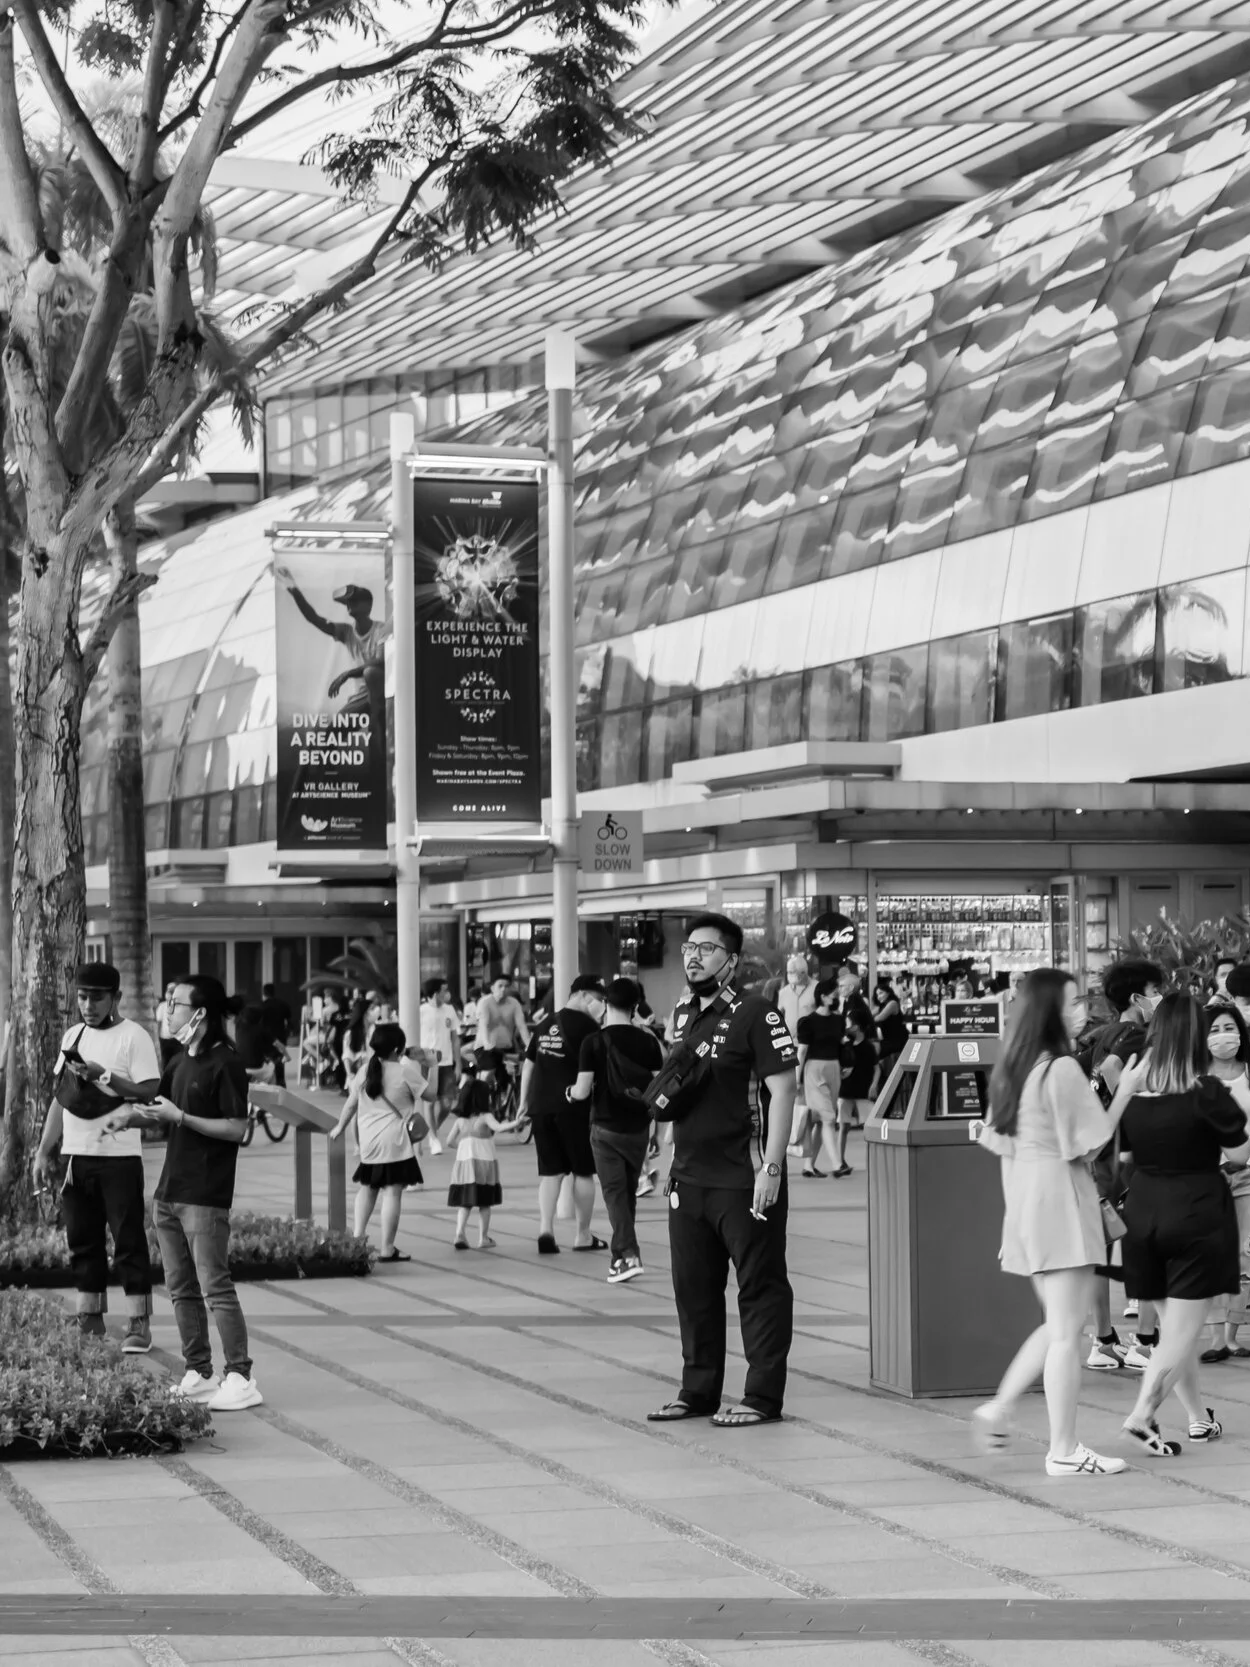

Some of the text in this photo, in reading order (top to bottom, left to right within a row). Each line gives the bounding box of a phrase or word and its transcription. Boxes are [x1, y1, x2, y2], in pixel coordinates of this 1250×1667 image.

[426, 621, 529, 633] EXPERIENCE THE
[431, 634, 524, 646] LIGHT & WATER
[453, 647, 502, 658] DISPLAY
[445, 688, 511, 700] SPECTRA
[293, 713, 370, 728] DIVE INTO
[290, 731, 372, 747] A REALITY
[299, 750, 364, 766] BEYOND
[304, 782, 359, 791] VR GALLERY
[452, 804, 506, 812] COME ALIVE
[594, 843, 631, 856] SLOW
[594, 858, 632, 871] DOWN
[950, 1016, 996, 1024] HAPPY HOUR
